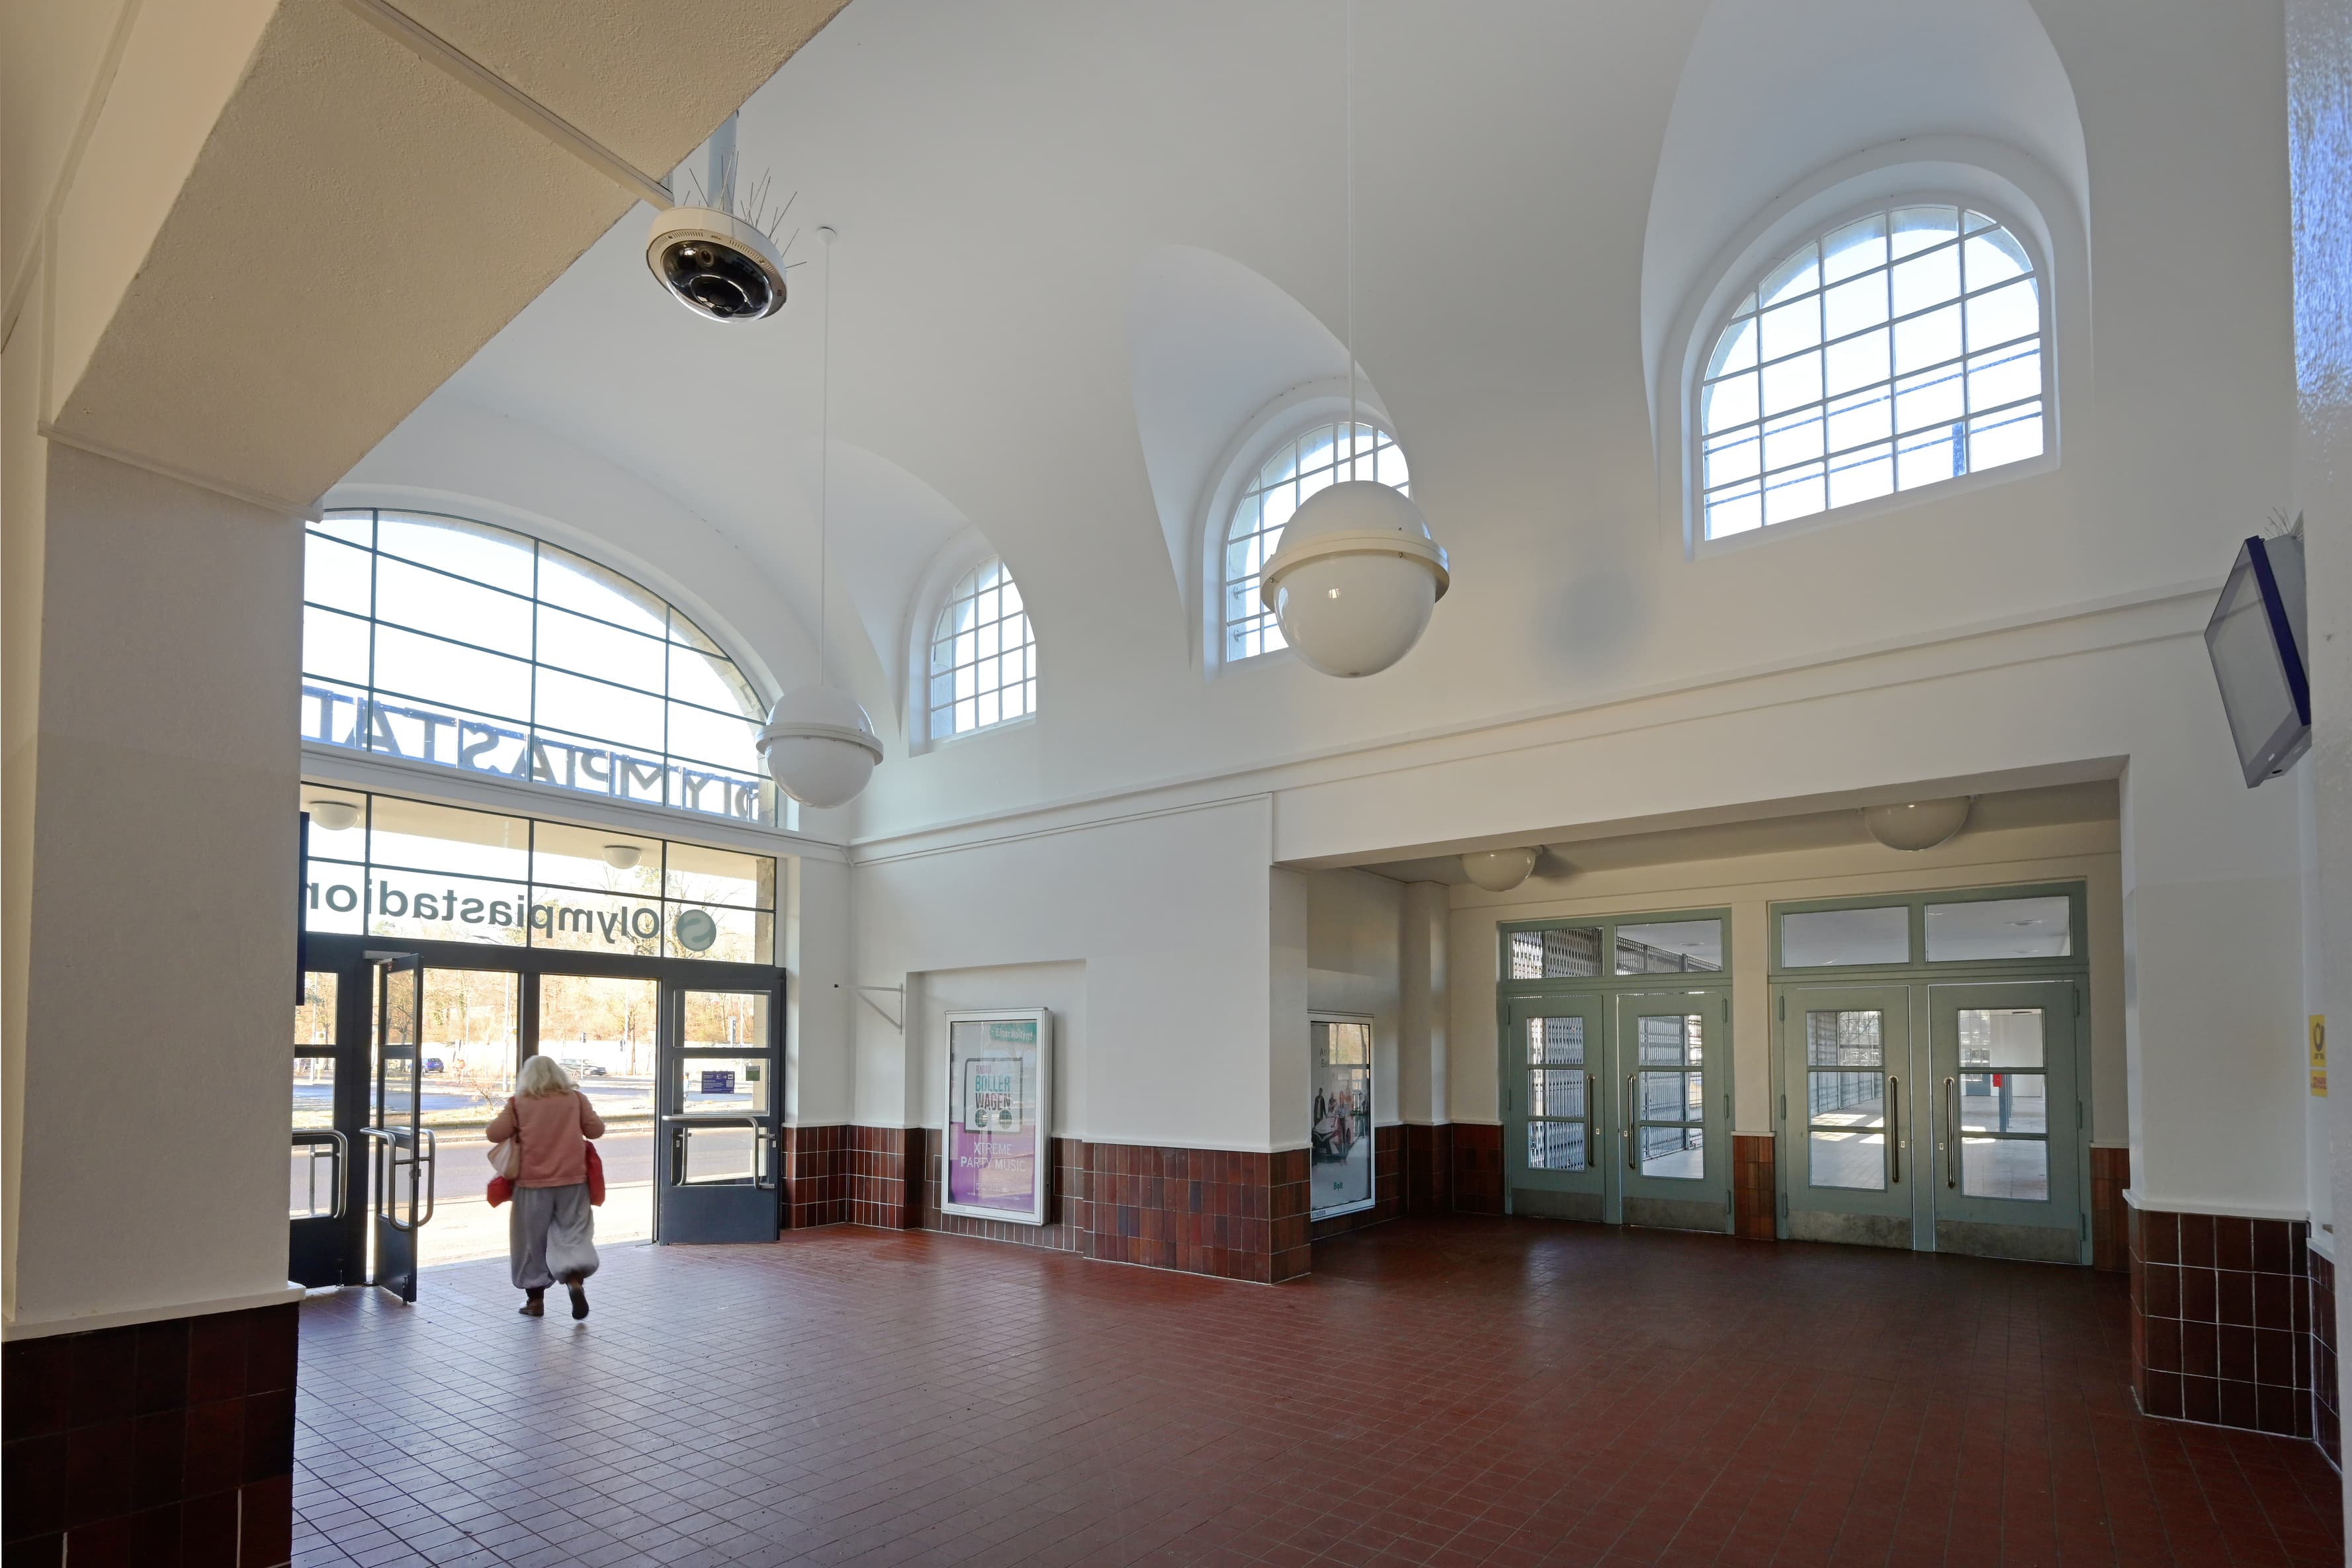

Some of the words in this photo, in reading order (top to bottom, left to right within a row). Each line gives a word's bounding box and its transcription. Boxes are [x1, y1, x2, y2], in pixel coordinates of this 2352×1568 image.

[976, 1065, 992, 1074] RADIO
[975, 1075, 1011, 1092] BOLLER
[975, 1093, 1011, 1110] WAGEN
[973, 1142, 1013, 1155] XTREME
[961, 1156, 992, 1170] PARTY
[994, 1158, 1027, 1172] MUSIC
